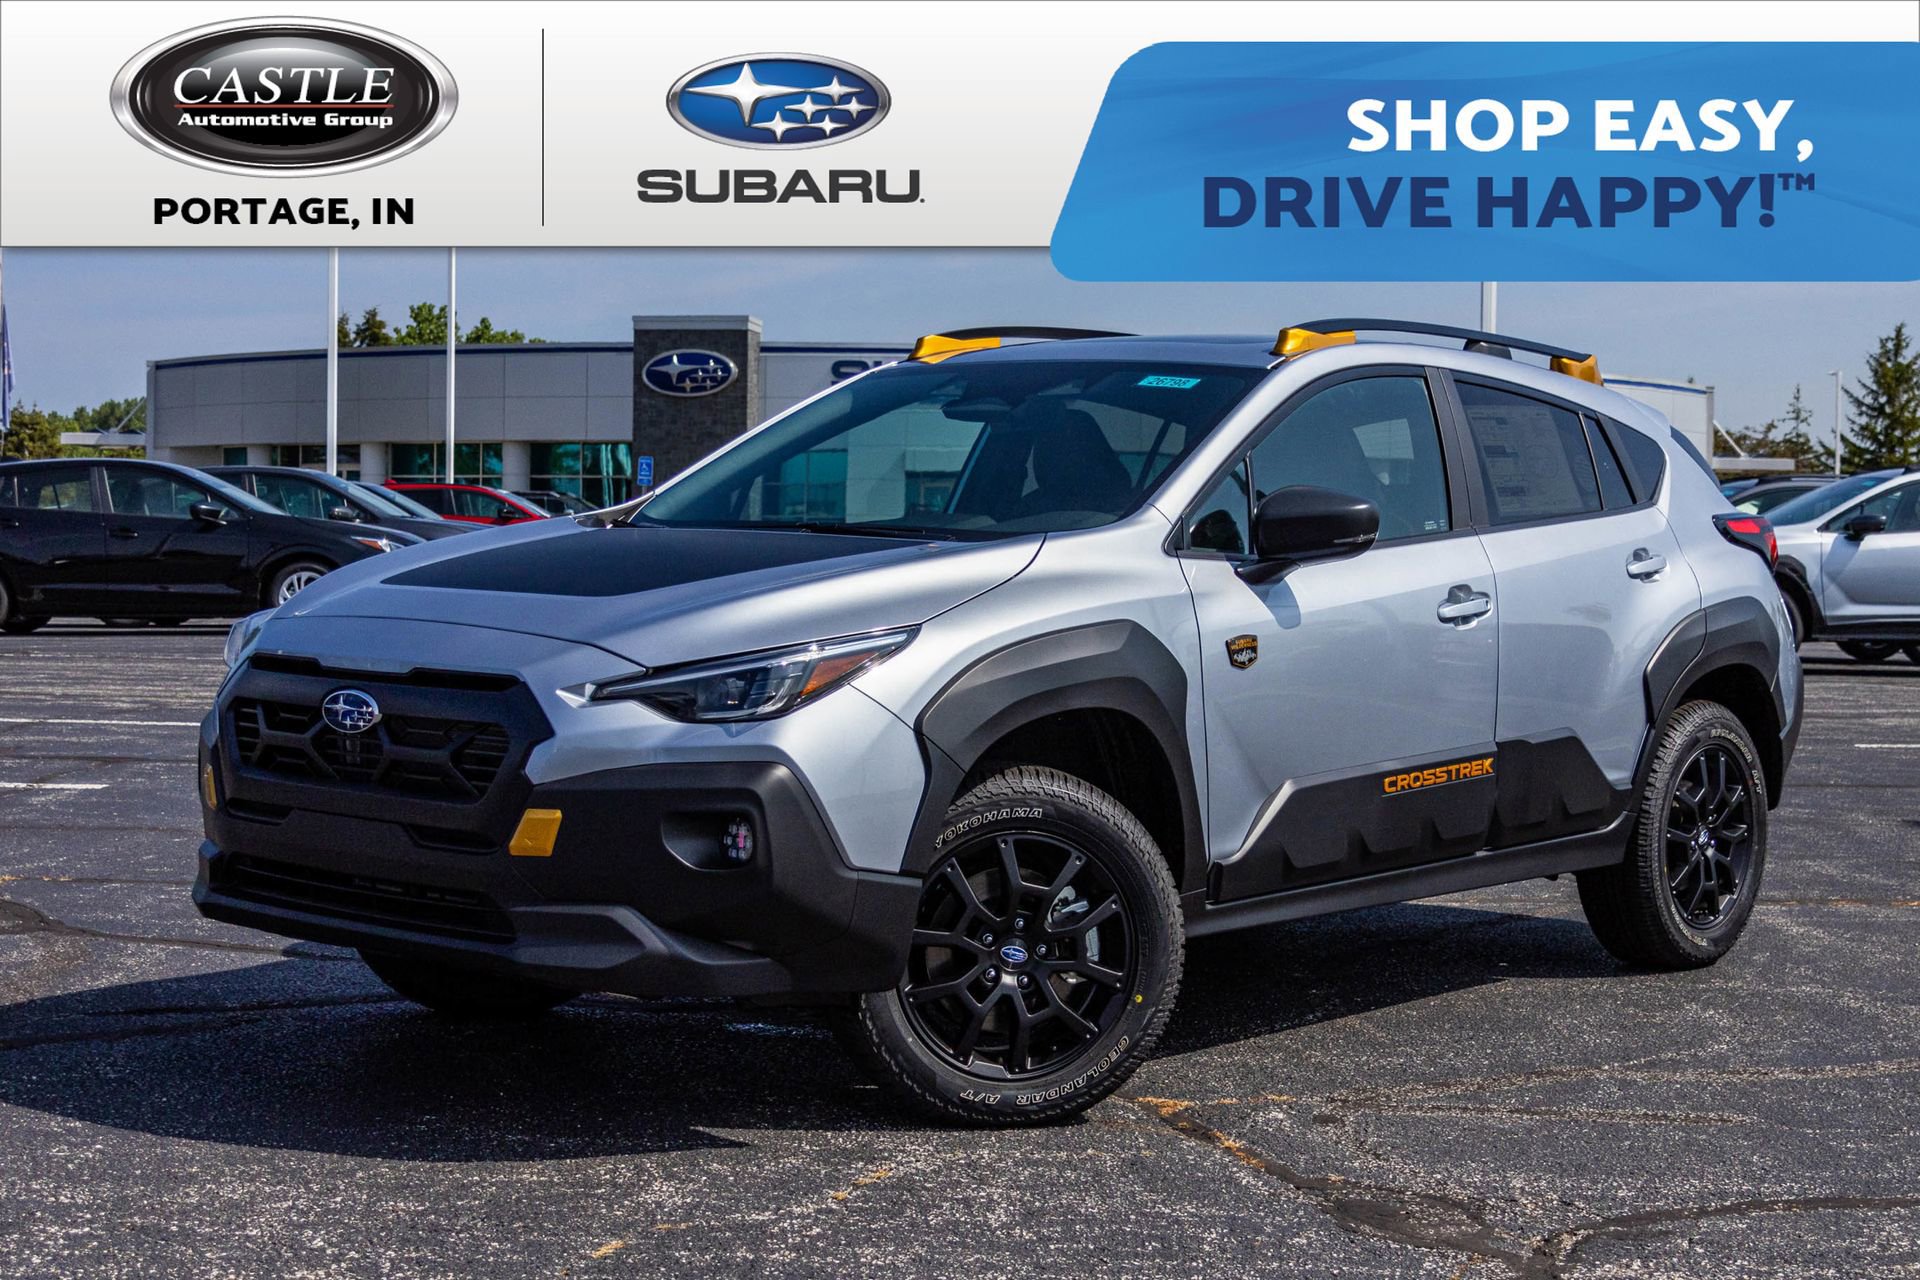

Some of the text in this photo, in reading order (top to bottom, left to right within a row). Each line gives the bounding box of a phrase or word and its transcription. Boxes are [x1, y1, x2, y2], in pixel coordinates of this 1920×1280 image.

[1383, 757, 1495, 793] CROSSTREK
[935, 807, 1043, 848] YOKOHAMA
[959, 1035, 1130, 1105] GEOLANDAR A/T
